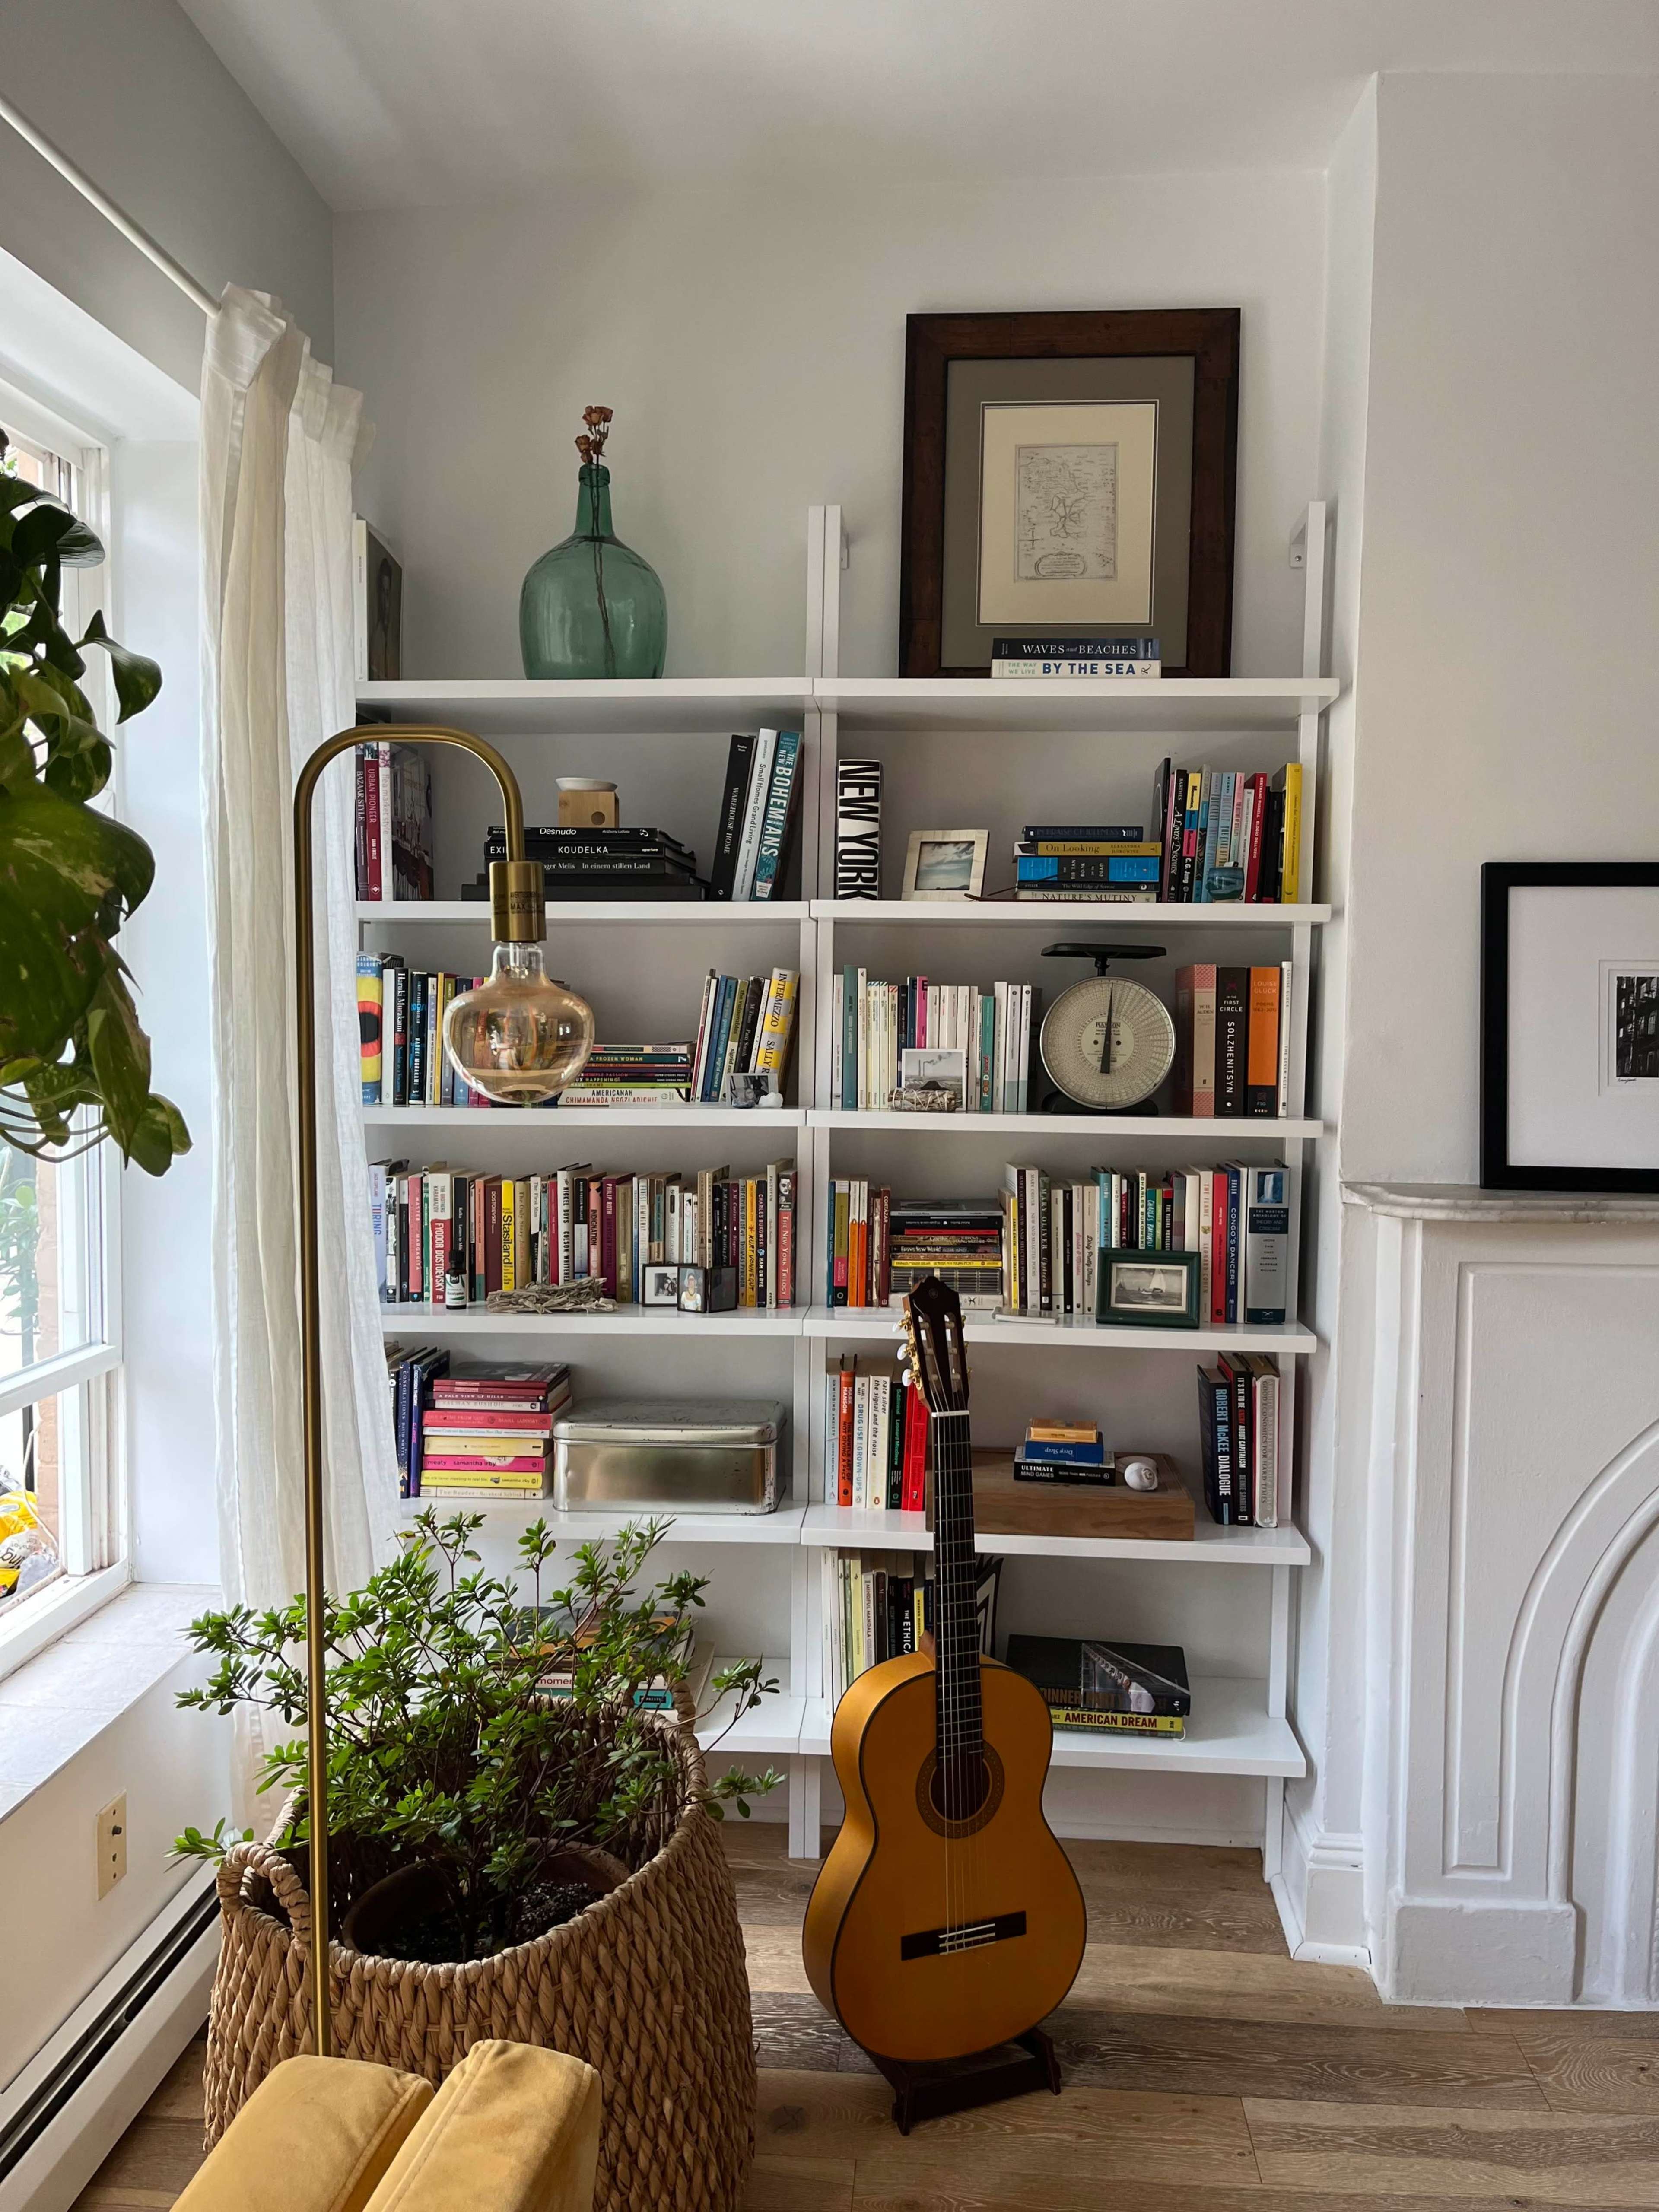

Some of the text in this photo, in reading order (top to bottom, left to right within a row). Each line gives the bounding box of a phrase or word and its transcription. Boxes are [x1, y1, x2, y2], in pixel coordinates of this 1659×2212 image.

[1023, 645, 1065, 654] WAVES
[1079, 645, 1136, 654] BEACHES
[1042, 663, 1135, 674] BY THE SEA
[778, 750, 795, 765] THE NEW
[368, 769, 377, 823] URBAN PIONEER
[746, 764, 766, 844] Small Homes Grand Living
[761, 766, 792, 857] BOHEMIANS
[724, 787, 739, 854] WAREHOUSE HOME
[838, 760, 880, 900] NEW YORK
[1063, 844, 1100, 853] Looking
[1095, 893, 1137, 902] MUTINY
[733, 1001, 744, 1034] vulnerables
[763, 973, 787, 1066] INTERMEZZO SALLY
[1226, 1021, 1235, 1093] SOLZHENITSYN
[372, 1204, 382, 1235] TURING
[435, 1223, 444, 1248] FYODOR
[502, 1215, 512, 1265] Stasiland
[435, 1250, 444, 1292] DOSTOEVSKY
[1215, 1389, 1230, 1496] ROBERT McKEE DIALOGUE
[903, 1621, 911, 1653] ETHICA
[1065, 1713, 1157, 1728] AMERICAN DREAM
